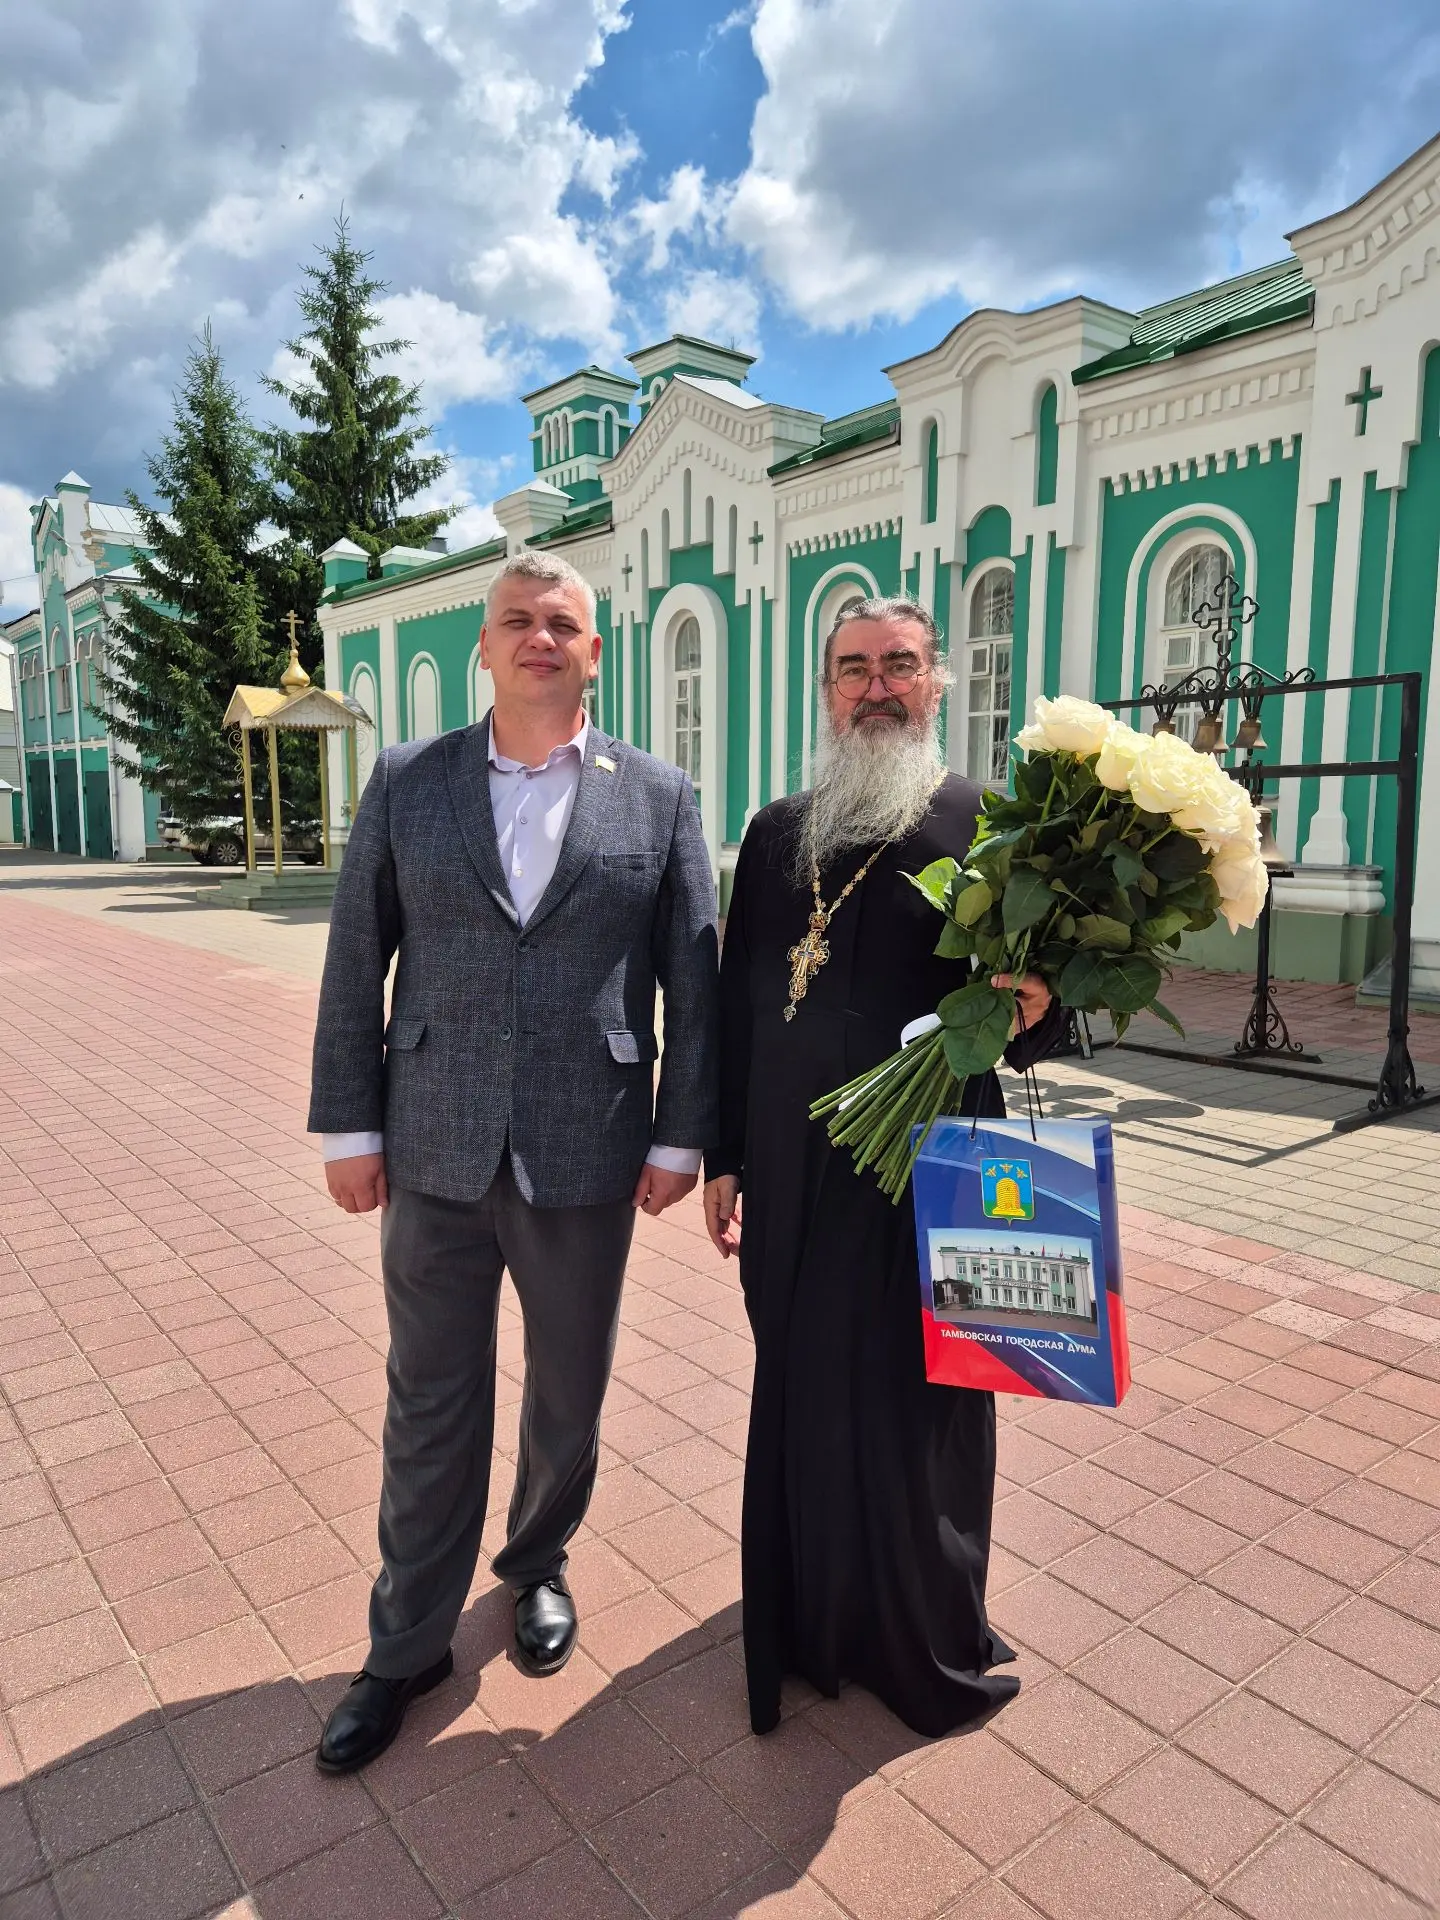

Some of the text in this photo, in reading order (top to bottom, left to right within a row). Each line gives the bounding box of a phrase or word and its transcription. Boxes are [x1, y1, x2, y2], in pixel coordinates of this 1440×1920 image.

[941, 1329, 1096, 1355] ТАМБОВСКАЯ ГОРОДСКАЯ ДУМА
